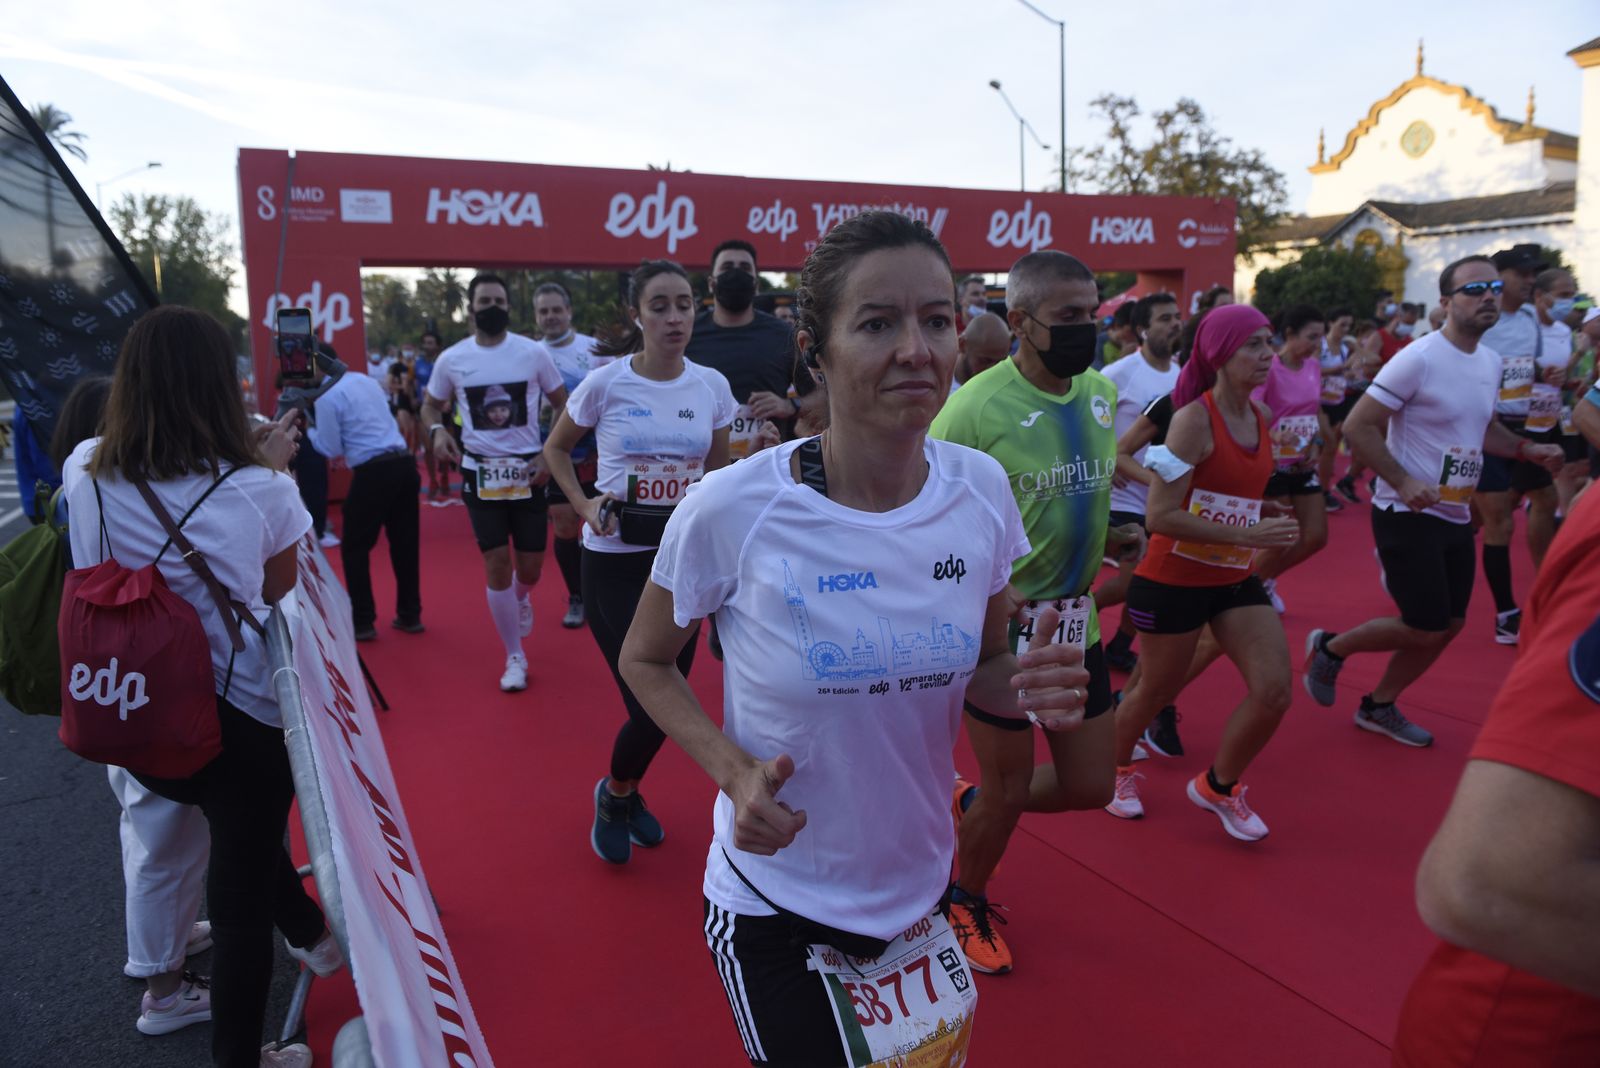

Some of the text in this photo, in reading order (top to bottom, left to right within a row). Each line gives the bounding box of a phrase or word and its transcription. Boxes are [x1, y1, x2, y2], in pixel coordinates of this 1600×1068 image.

[290, 186, 325, 202] IMD
[426, 188, 543, 227] HOKA
[605, 180, 698, 254] edp
[747, 200, 798, 242] edp
[987, 199, 1053, 252] edp
[1089, 217, 1155, 245] HOKA
[262, 281, 355, 344] edp
[628, 408, 653, 417] HOKA
[679, 408, 694, 421] edp
[484, 467, 520, 481] 5146
[634, 463, 650, 473] edp
[662, 464, 677, 473] edp
[1019, 456, 1115, 493] CAMPILLO
[818, 572, 877, 593] HOKA
[933, 554, 966, 584] edp
[1018, 618, 1076, 644] 416
[69, 657, 150, 721] edp
[832, 686, 860, 695] Edición
[868, 680, 890, 695] edp
[911, 671, 948, 685] maratón
[900, 950, 924, 967] SEVILLA
[924, 941, 938, 953] 2021
[843, 955, 939, 1027] 5877
[927, 1015, 963, 1042] GARCÍA
